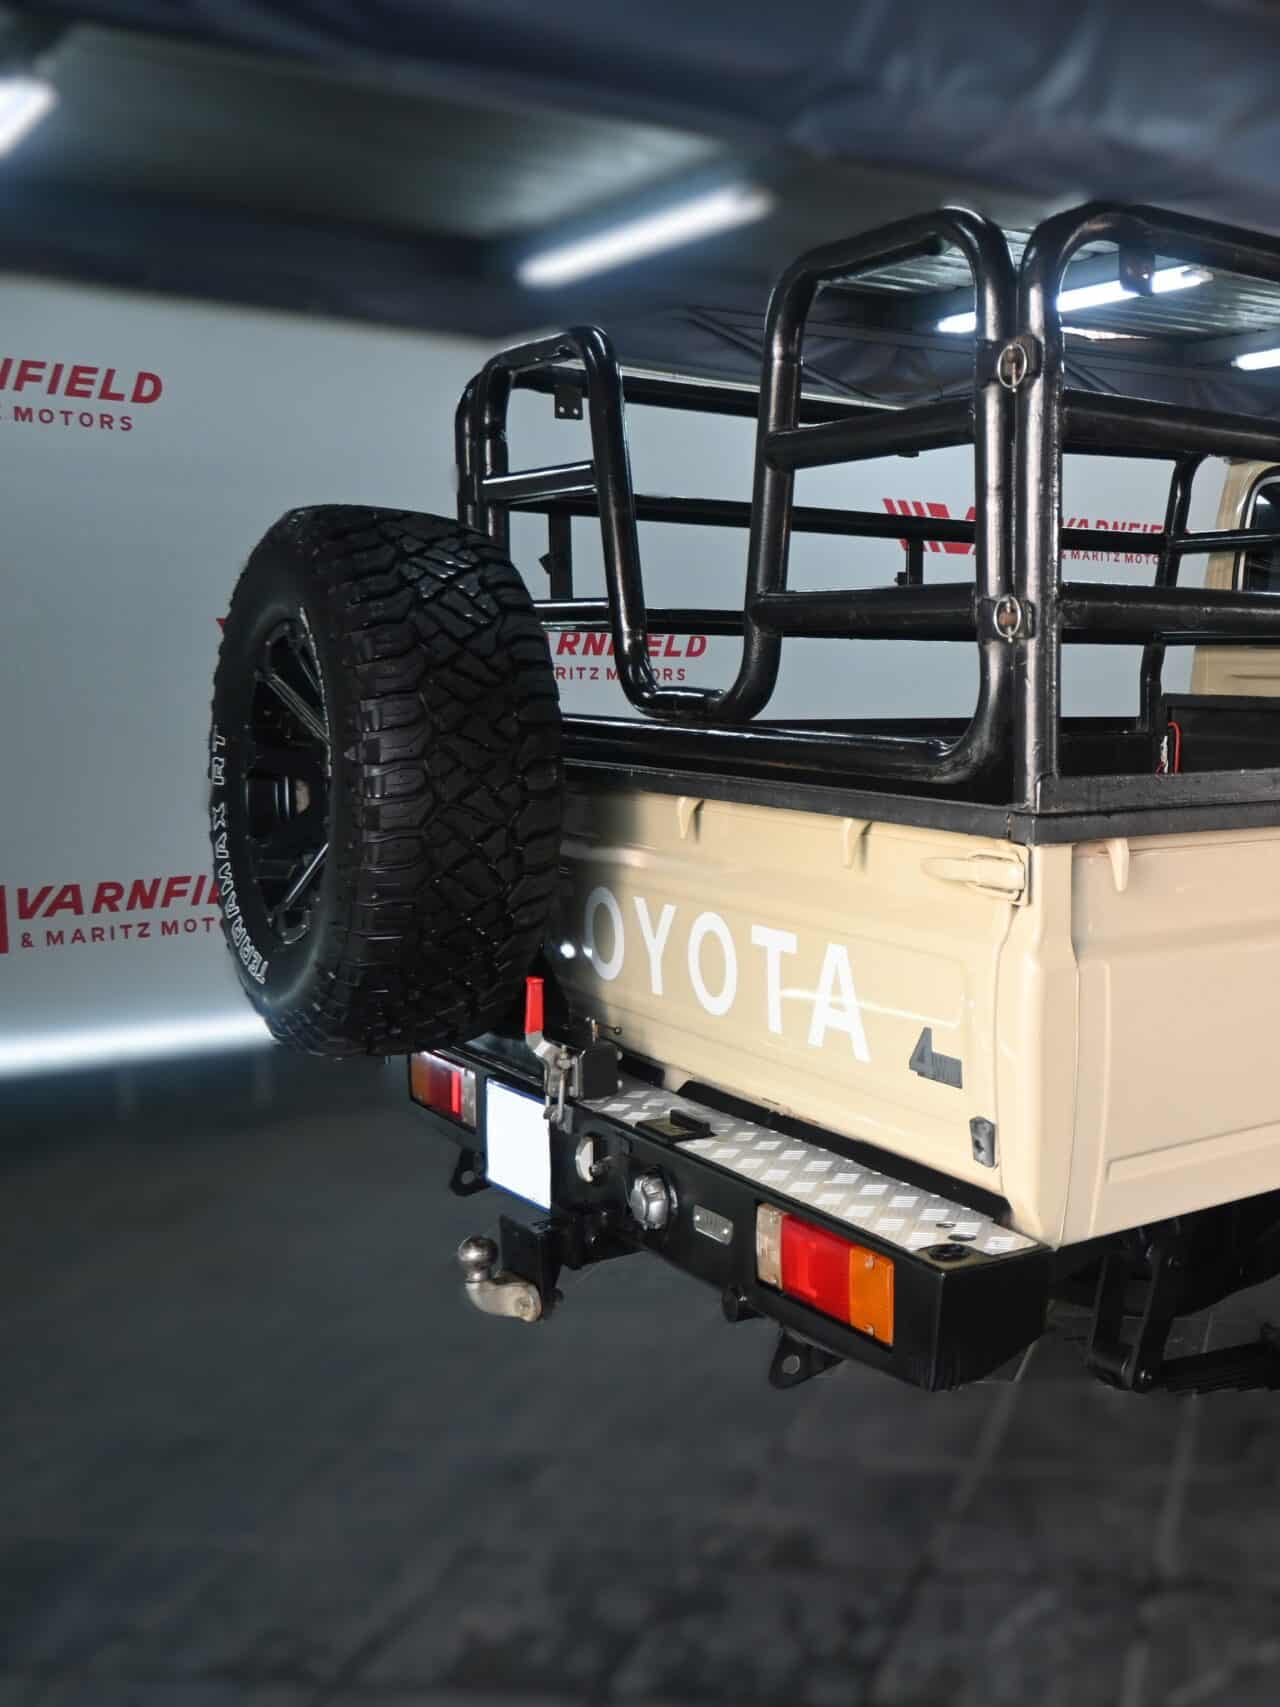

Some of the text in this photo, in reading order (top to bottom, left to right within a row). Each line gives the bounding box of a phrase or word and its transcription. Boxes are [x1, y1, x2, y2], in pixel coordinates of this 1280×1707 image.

[13, 405, 134, 432] MOTORS
[606, 667, 687, 681] MORS
[211, 802, 270, 985] TERRAMAX
[20, 916, 225, 949] & MARITZ MOT
